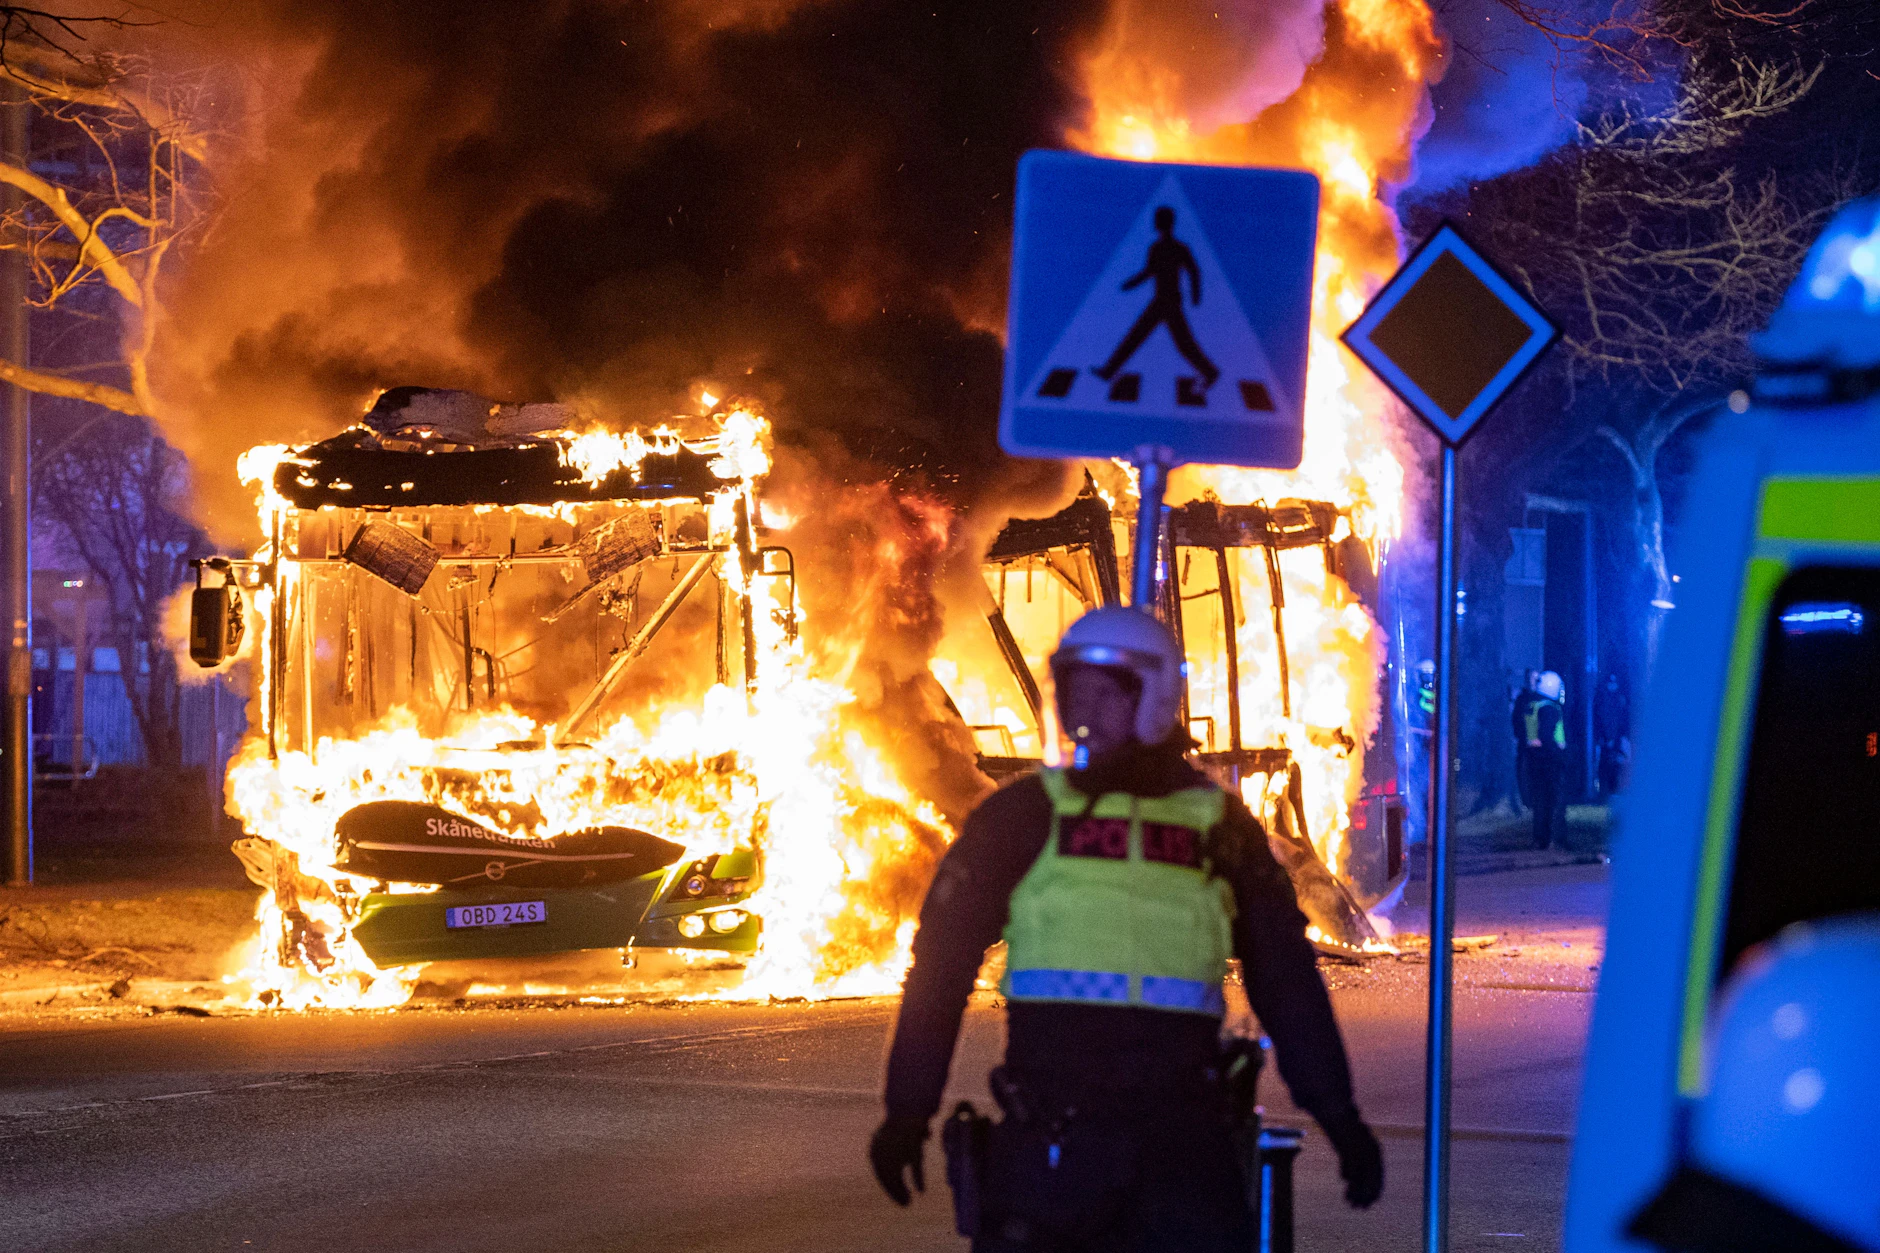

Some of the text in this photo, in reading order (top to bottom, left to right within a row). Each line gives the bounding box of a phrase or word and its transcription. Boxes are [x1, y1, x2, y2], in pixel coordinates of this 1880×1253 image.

[1070, 819, 1194, 863] POLIS
[462, 904, 537, 925] OBD 24S
